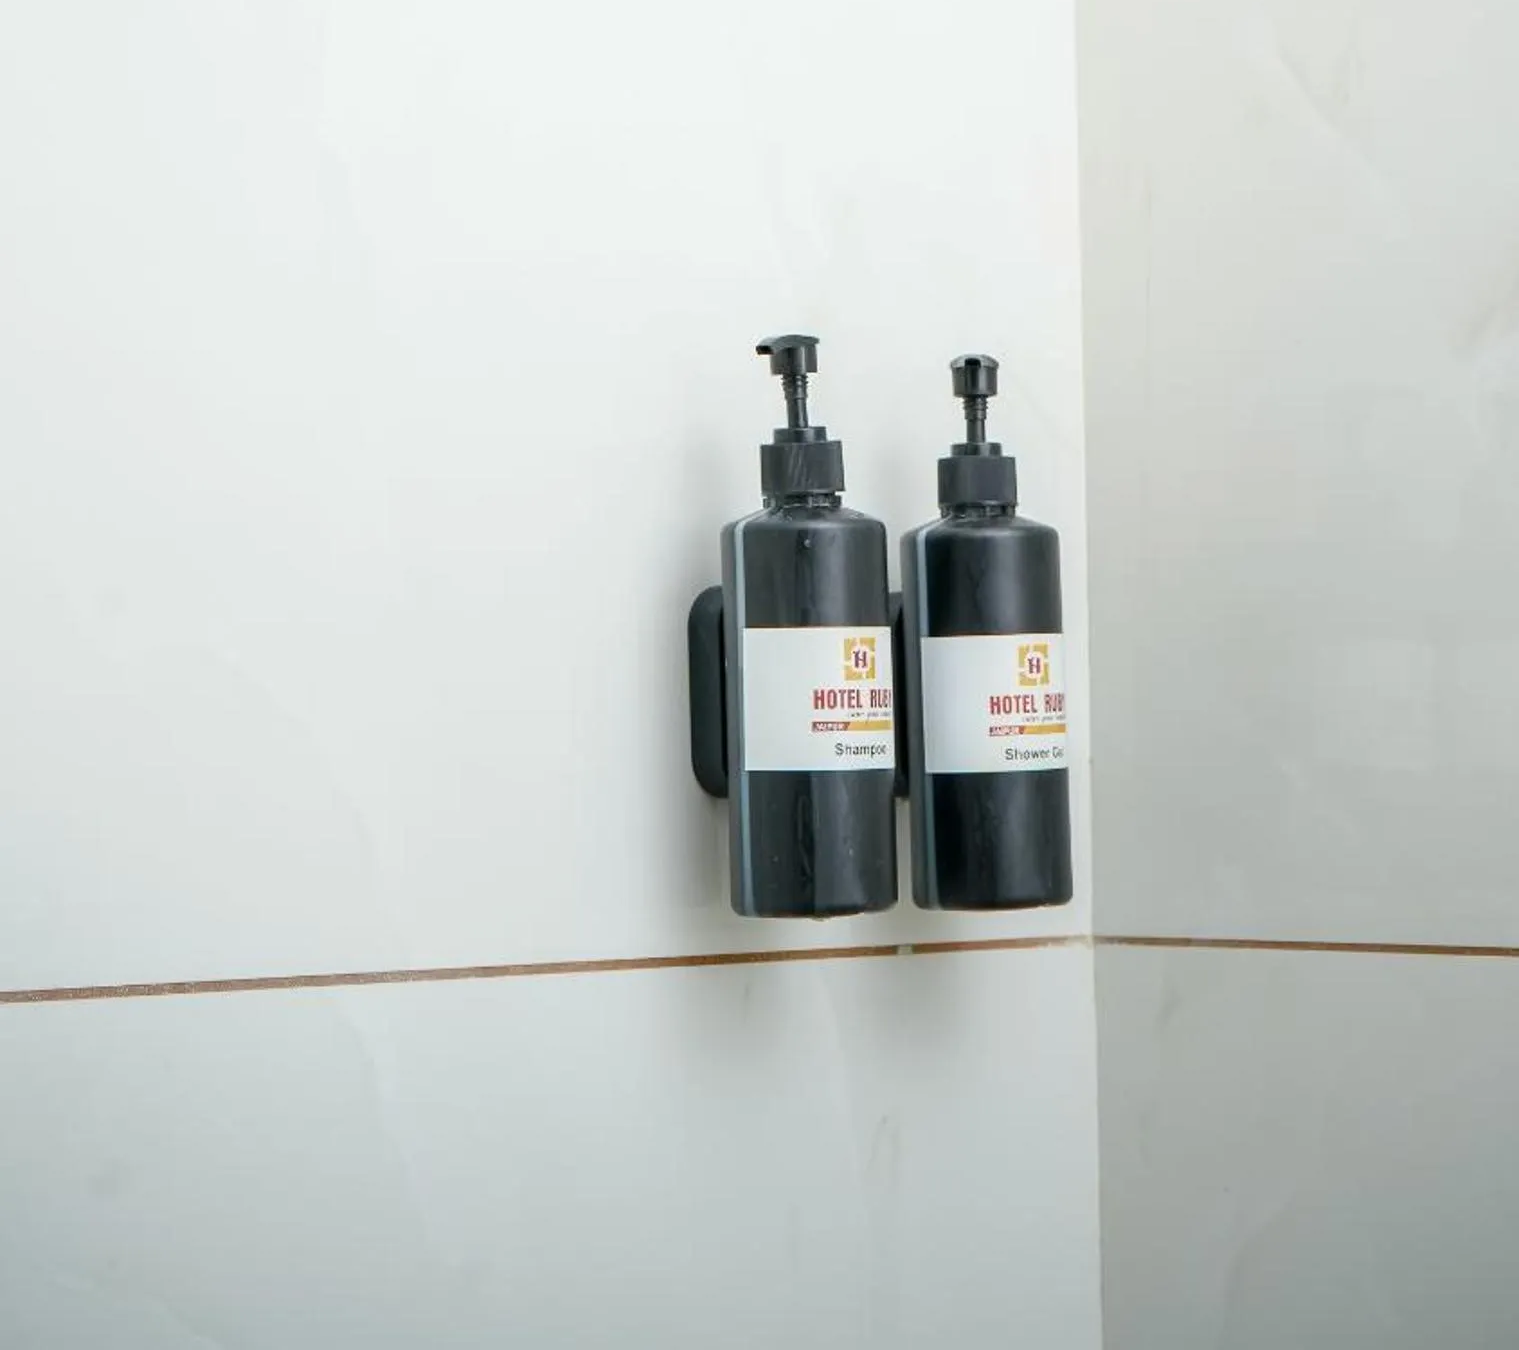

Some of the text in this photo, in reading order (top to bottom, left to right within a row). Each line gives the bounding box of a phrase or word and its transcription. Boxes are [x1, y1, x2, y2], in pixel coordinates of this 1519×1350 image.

[813, 689, 863, 710] HOTEL
[989, 694, 1038, 715] HOTEL
[1004, 746, 1050, 761] Shower
